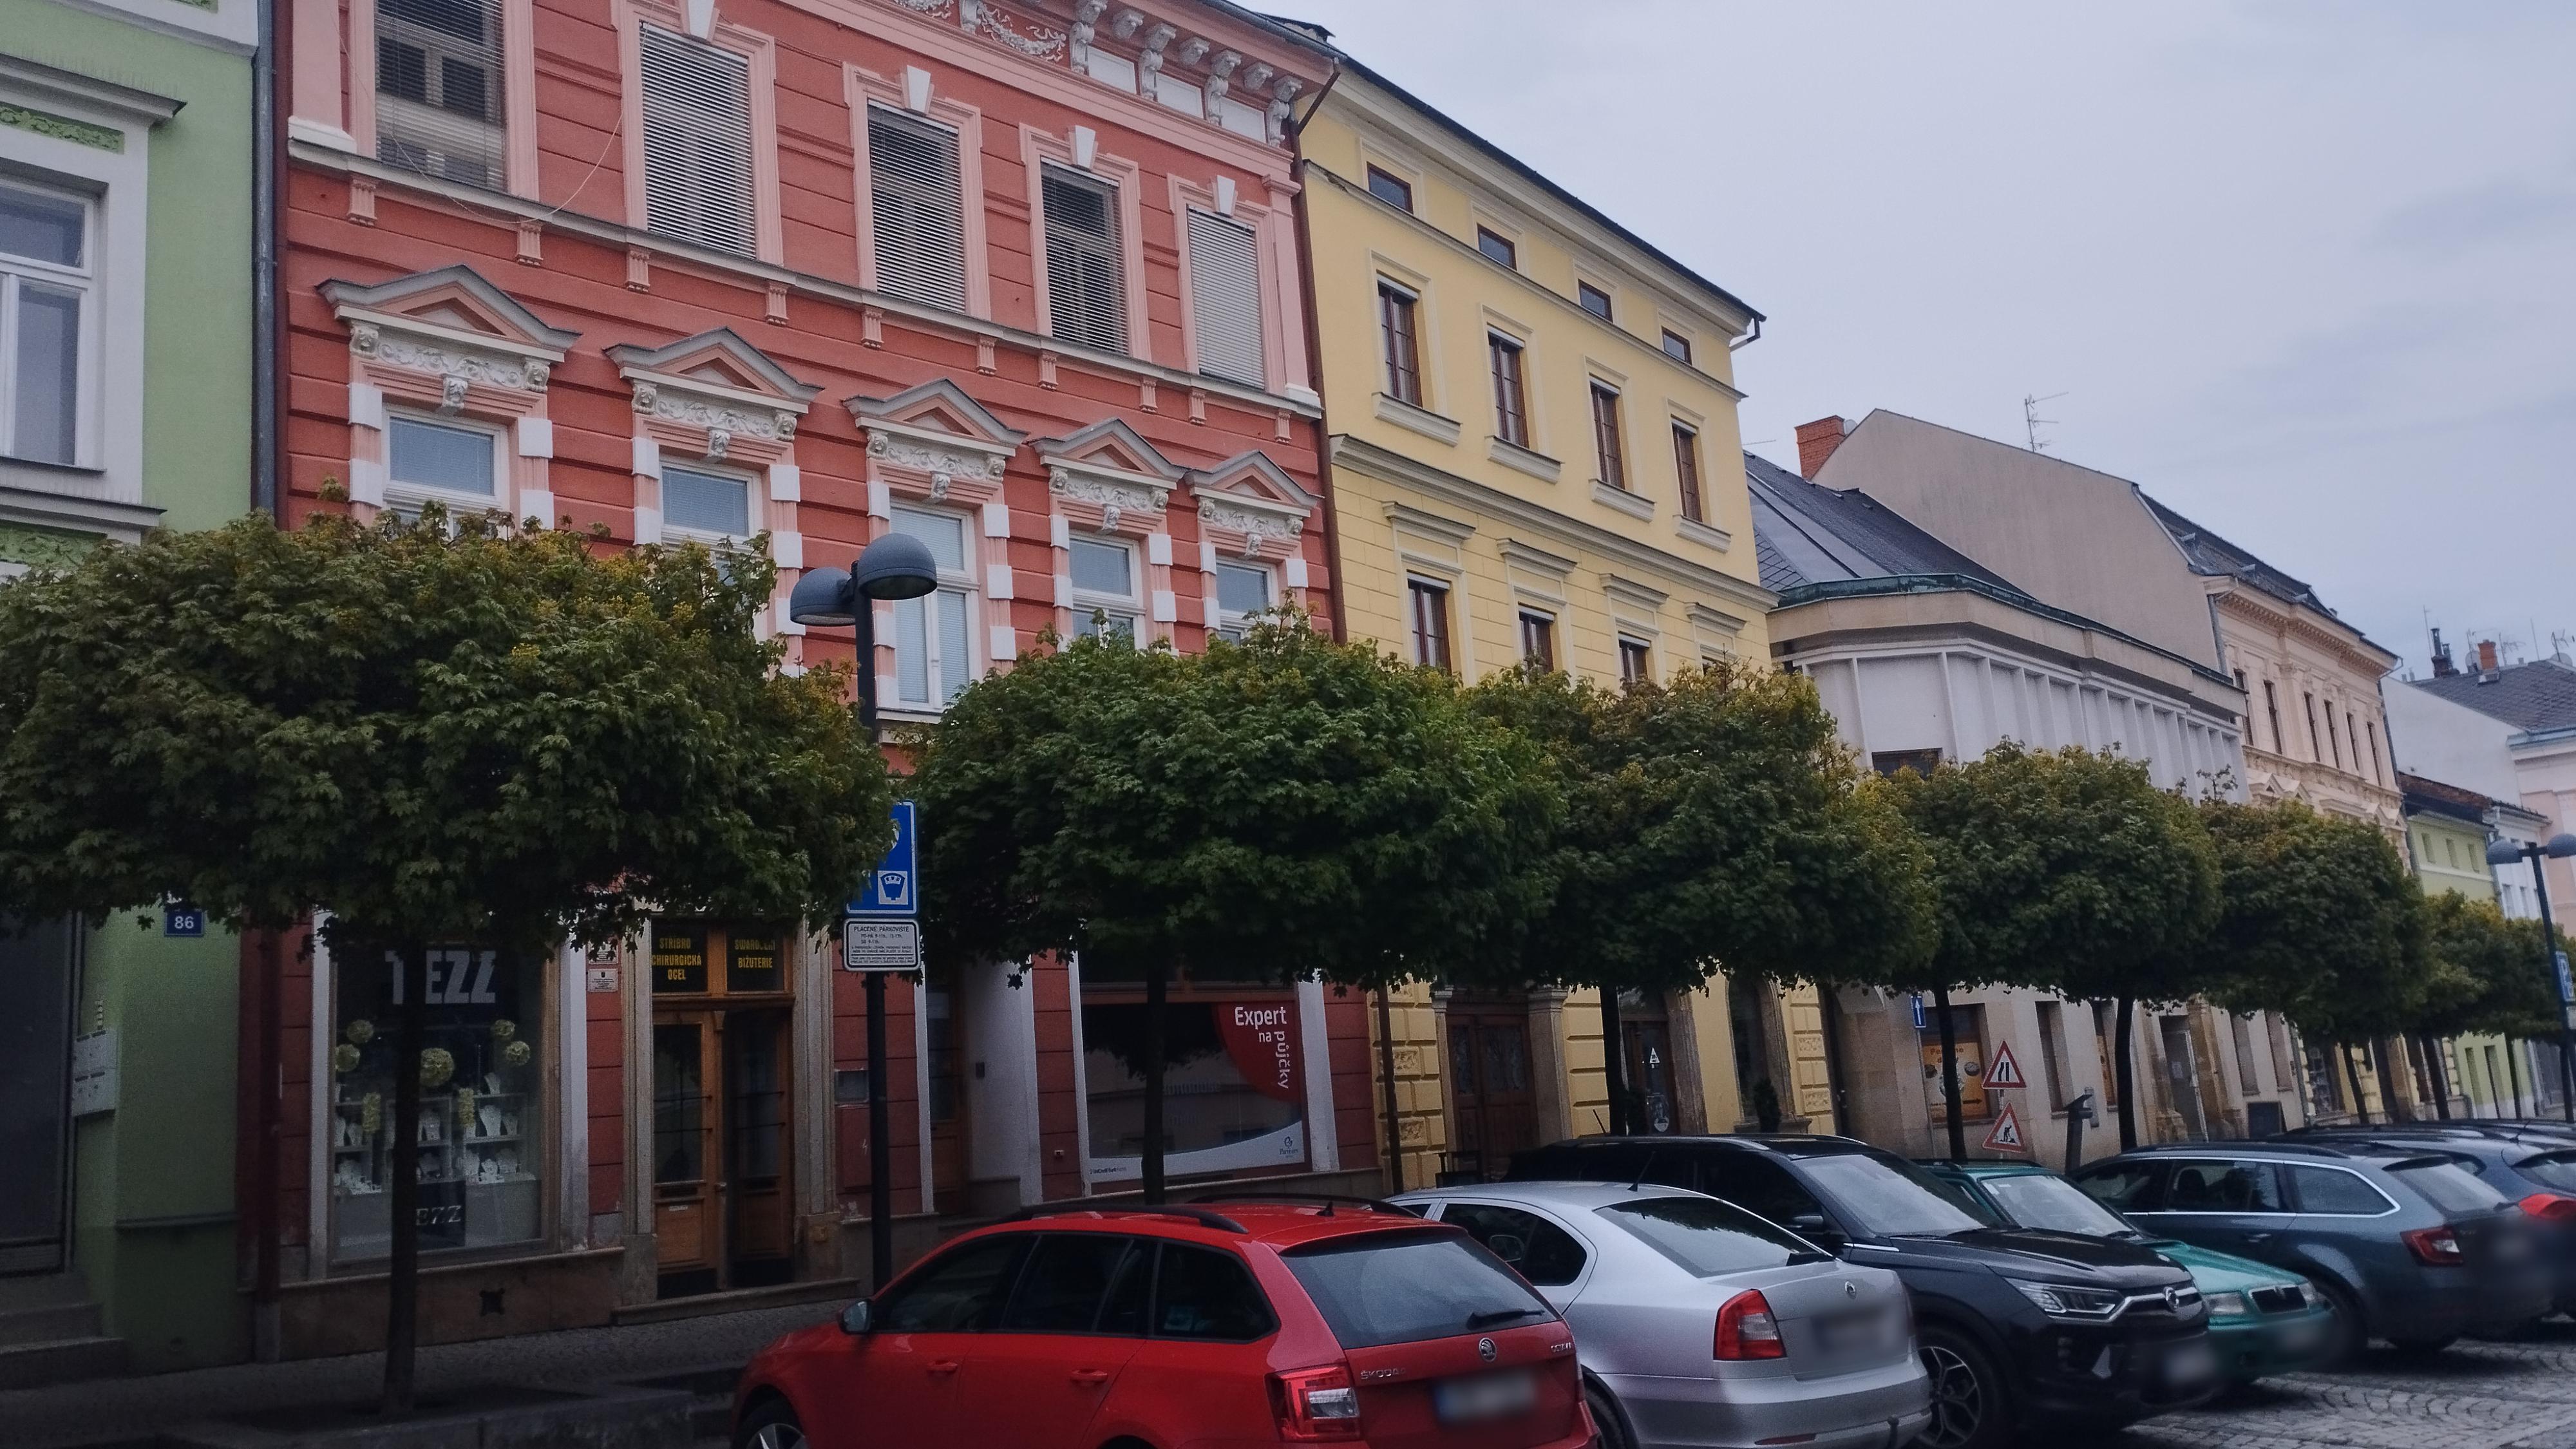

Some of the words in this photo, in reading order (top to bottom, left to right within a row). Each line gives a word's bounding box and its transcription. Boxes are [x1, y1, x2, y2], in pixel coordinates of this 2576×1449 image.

[174, 915, 194, 929] 86
[651, 952, 701, 966] CHIRURGICKÁ
[738, 956, 773, 969] BIŽUTERIE
[667, 968, 686, 981] OCEL
[1235, 1007, 1287, 1030] Expert
[1258, 1032, 1272, 1043] na
[1274, 1031, 1291, 1089] půjčky
